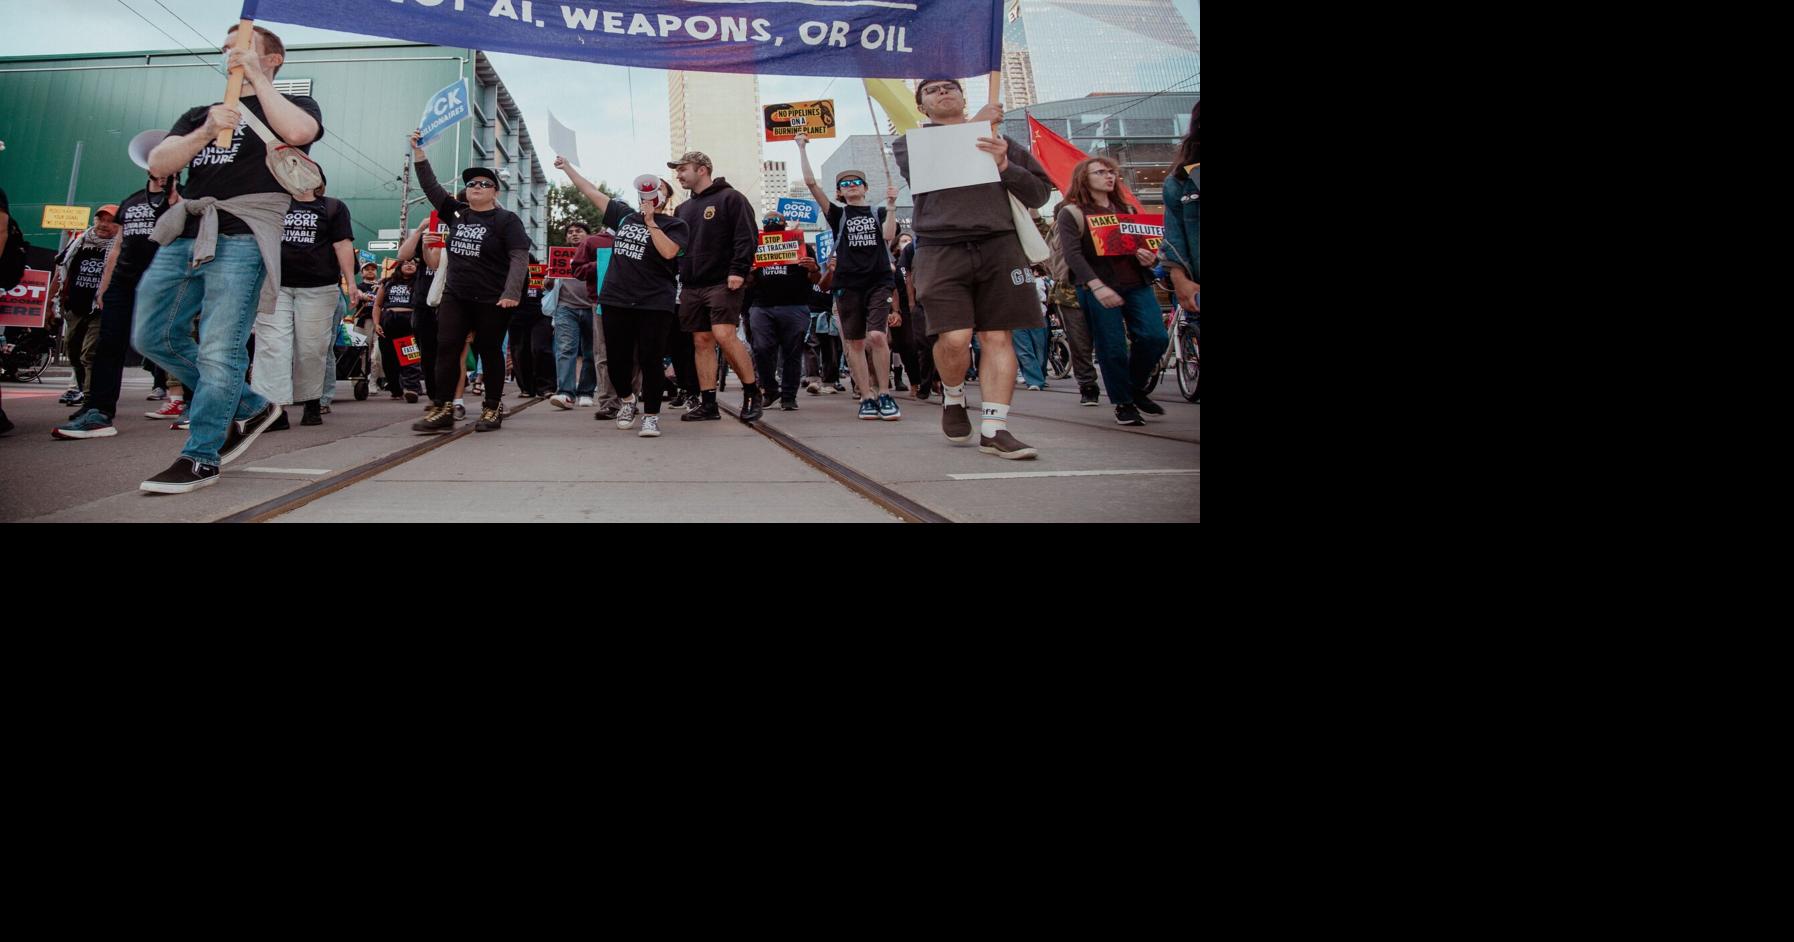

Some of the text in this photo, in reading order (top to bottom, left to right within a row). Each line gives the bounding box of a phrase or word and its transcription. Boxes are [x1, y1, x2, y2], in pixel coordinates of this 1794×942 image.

[489, 0, 913, 53] AI. WEAPONS, OR OIL
[428, 88, 462, 116] CK
[778, 108, 820, 118] NO PIPELINES
[420, 104, 465, 138] BILLIONAIRES
[791, 118, 800, 126] ON
[774, 126, 802, 135] BURNING
[783, 203, 812, 212] GOOD
[125, 211, 156, 219] WORK
[783, 210, 811, 219] WORK
[124, 221, 154, 230] LIVABLE
[284, 219, 317, 227] WORK
[846, 217, 876, 227] GOOD
[1090, 215, 1117, 226] MAKE
[457, 224, 487, 234] GOOD
[622, 224, 651, 236] GOOD
[847, 224, 876, 233] WORK
[456, 230, 484, 240] WORK
[618, 230, 649, 243] WORK
[765, 235, 780, 243] STOP
[848, 232, 876, 241] LIVABLE
[451, 240, 481, 251] LIVABLE
[614, 241, 645, 254] LIVABLE
[768, 241, 797, 252] TRACKING
[849, 239, 878, 247] FUTURE
[451, 247, 480, 257] FUTURE
[614, 248, 643, 260] FUTURE
[756, 252, 797, 261] DESTRUCTION
[553, 258, 567, 268] IS
[5, 285, 46, 298] OT
